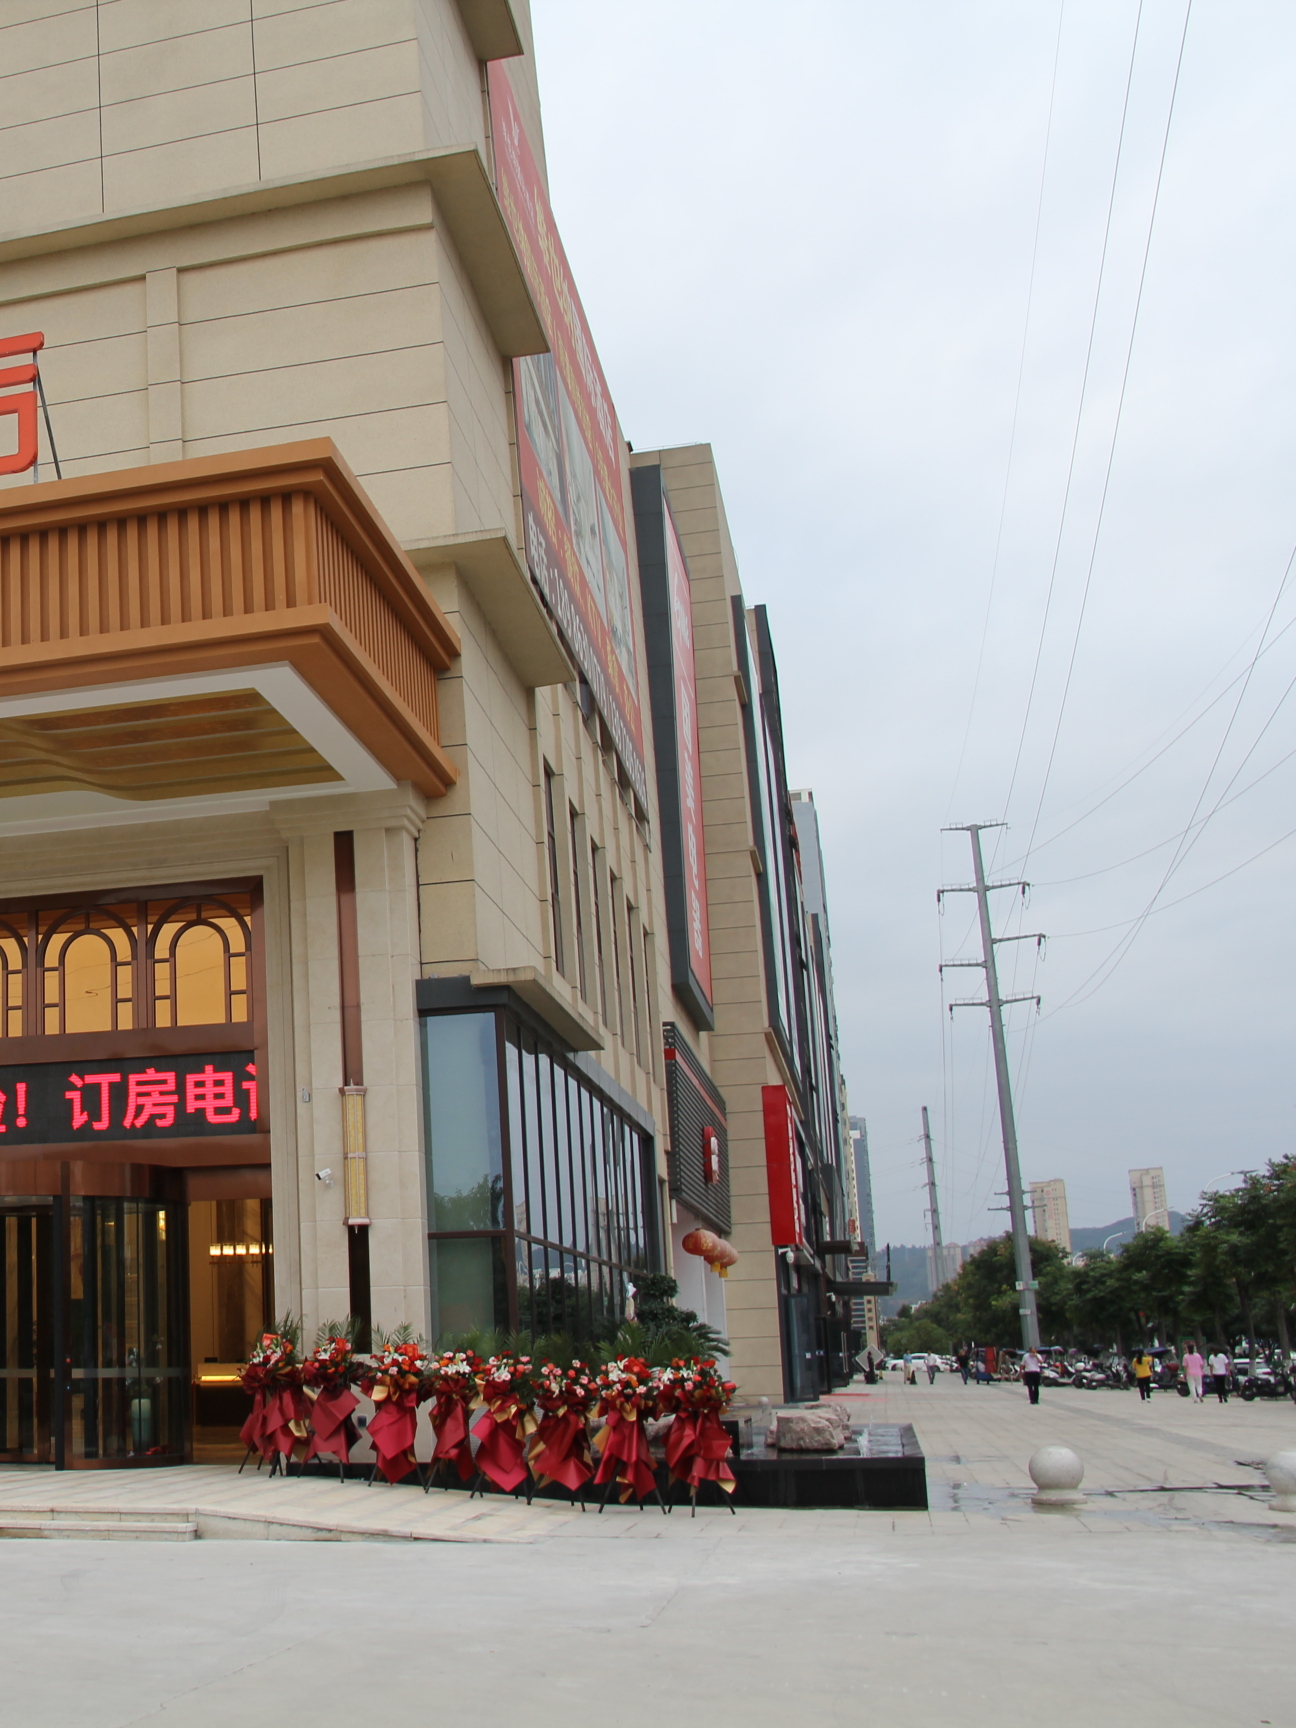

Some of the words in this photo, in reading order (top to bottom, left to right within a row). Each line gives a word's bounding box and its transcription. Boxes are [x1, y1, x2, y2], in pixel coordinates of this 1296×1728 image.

[534, 184, 616, 470] 维也纳国际酒店
